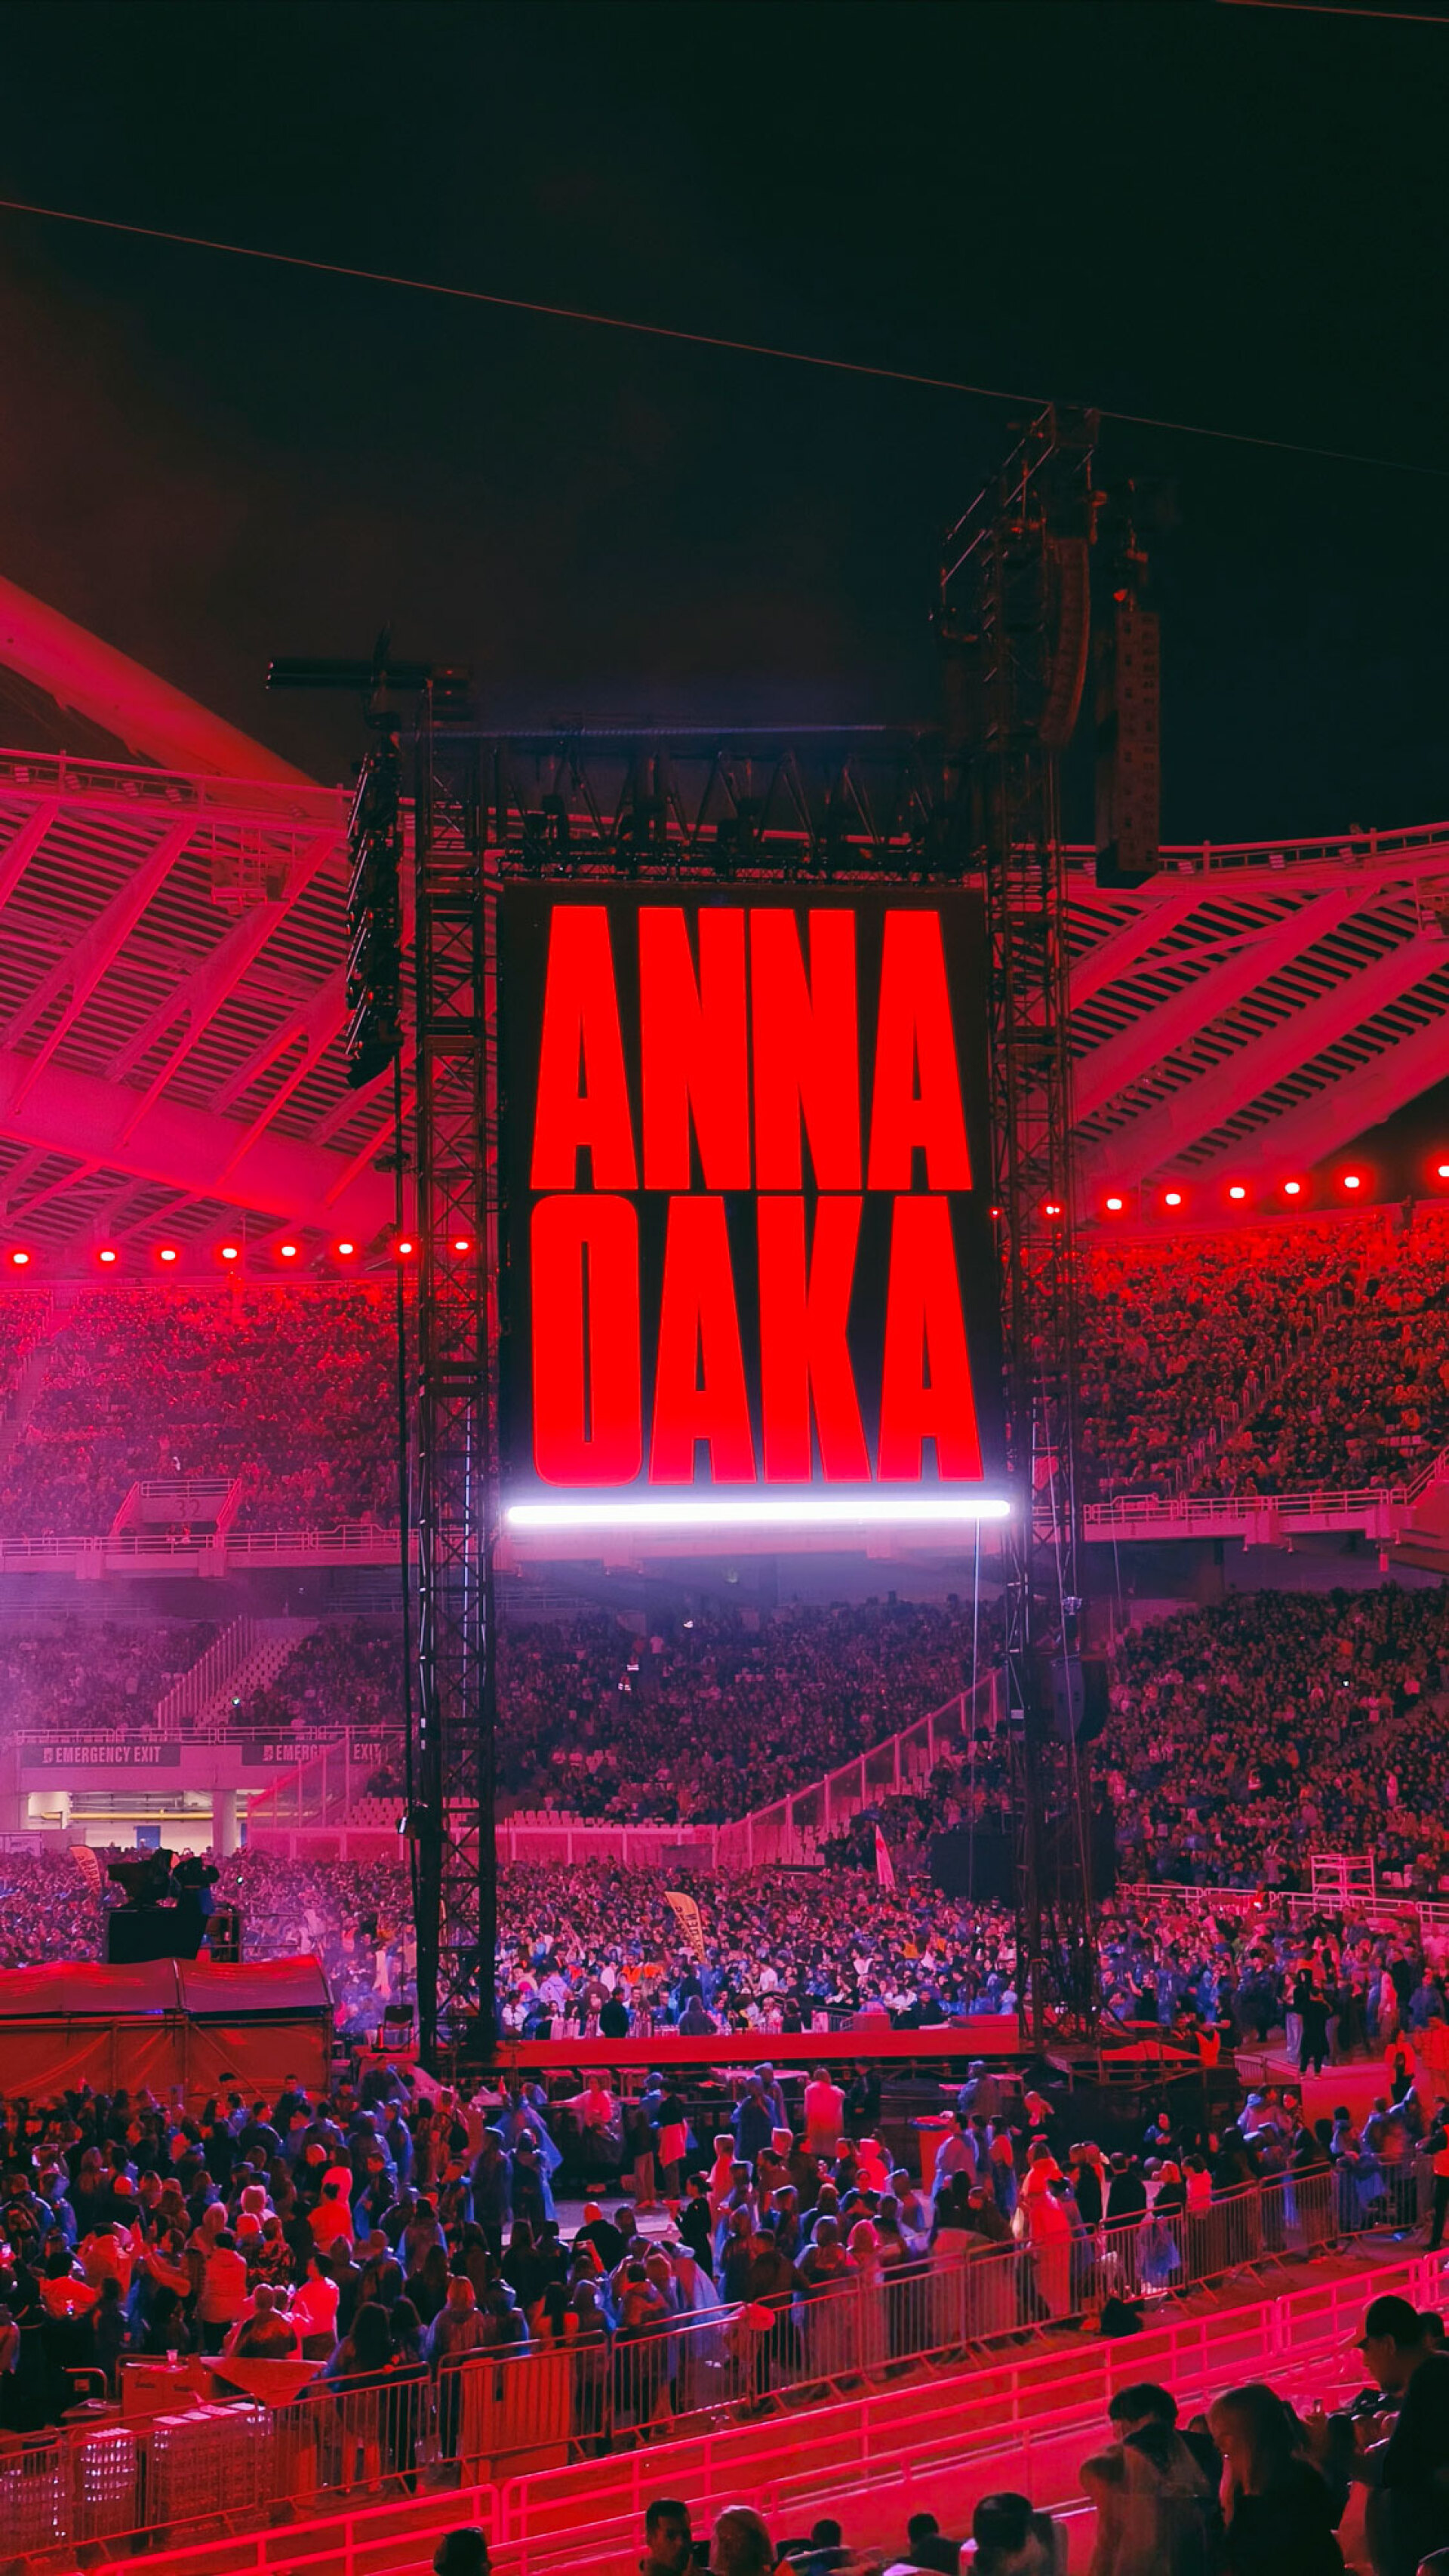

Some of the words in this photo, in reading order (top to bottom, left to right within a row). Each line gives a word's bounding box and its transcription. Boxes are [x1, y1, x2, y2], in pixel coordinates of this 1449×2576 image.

[530, 905, 973, 1190] ANNA
[530, 1195, 985, 1488] OAKA
[174, 1498, 202, 1518] 32
[56, 1746, 131, 1763] EMERGENCY
[134, 1746, 162, 1763] EXIT
[353, 1743, 381, 1761] EXIT
